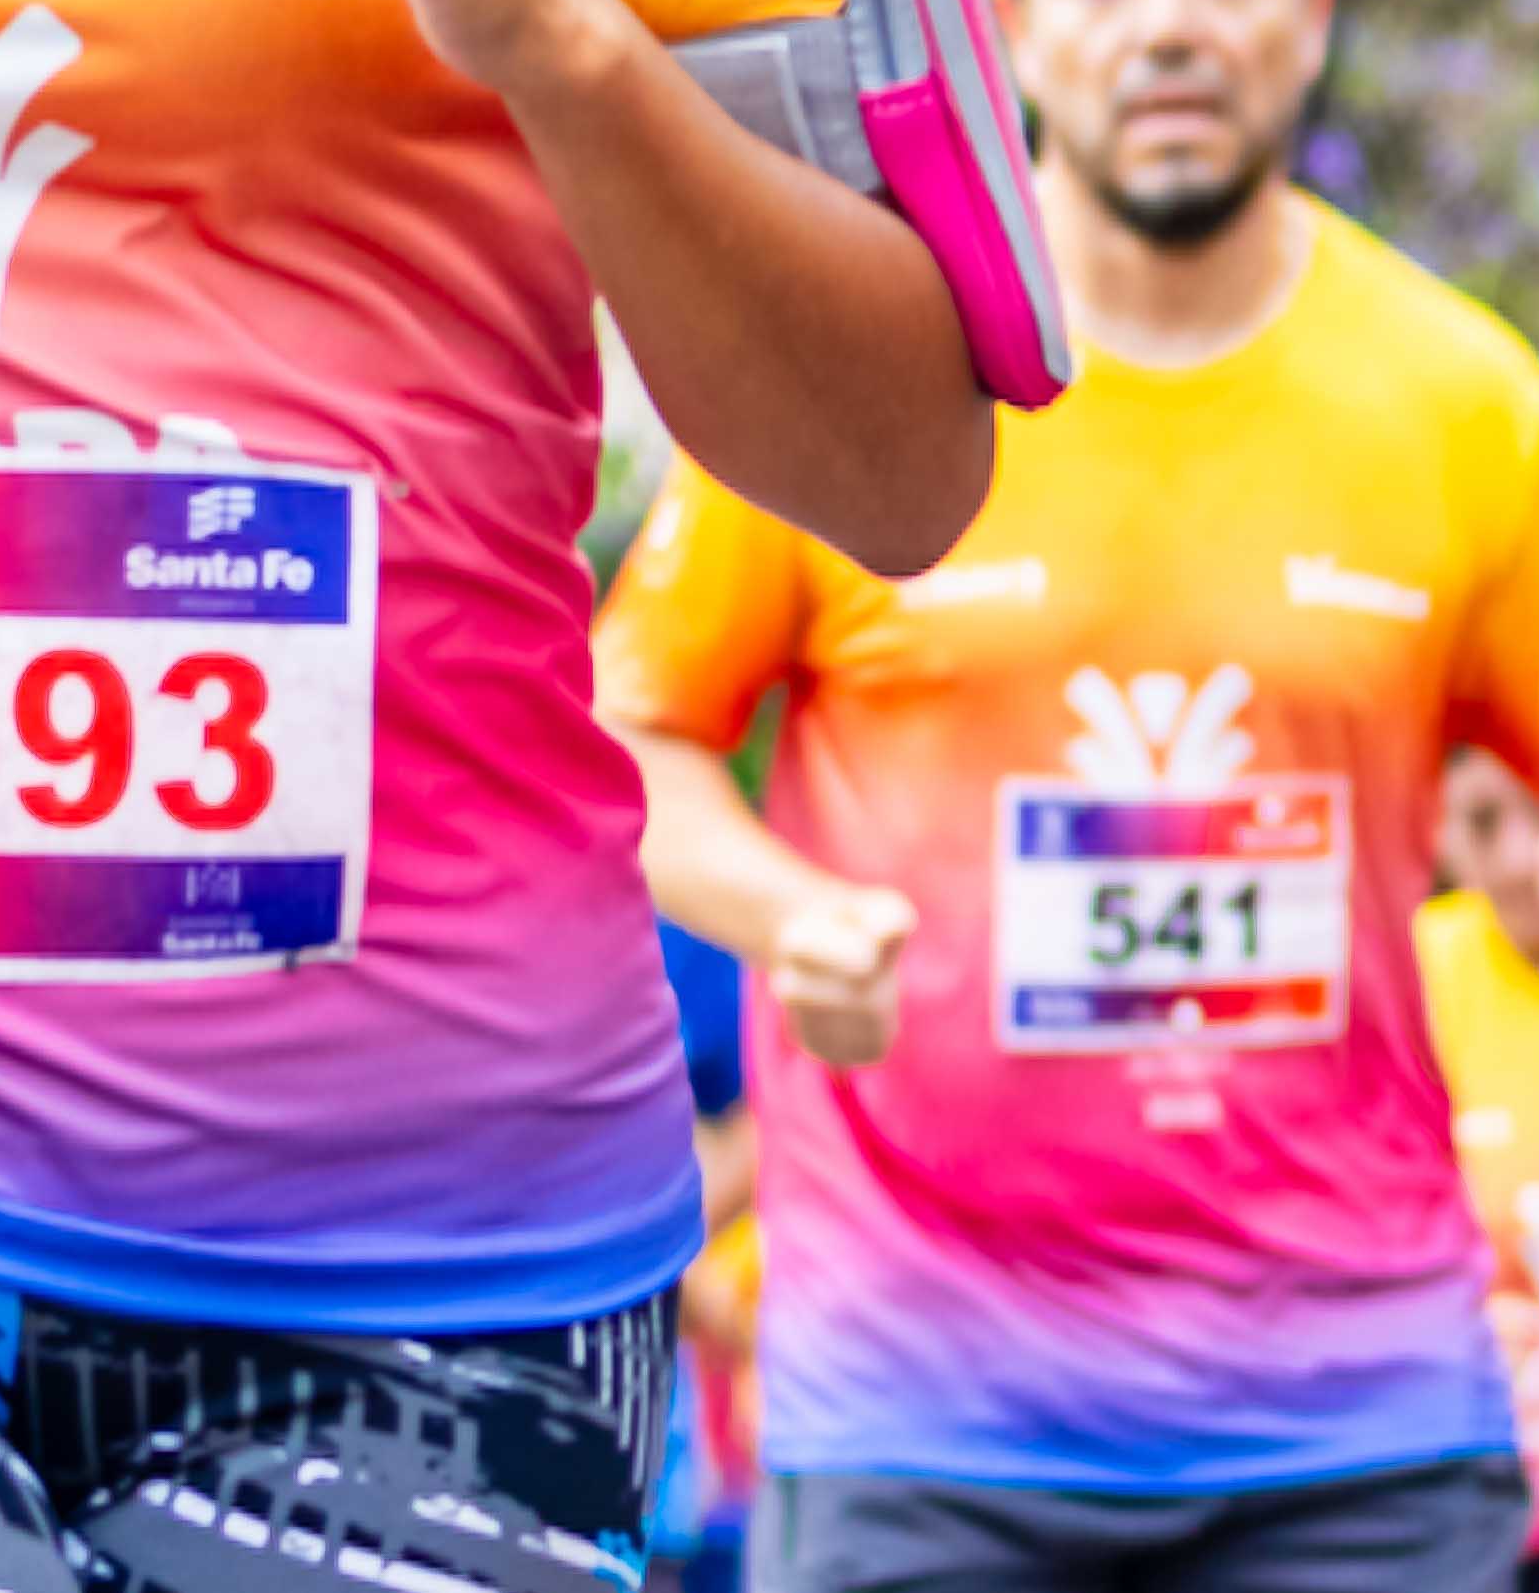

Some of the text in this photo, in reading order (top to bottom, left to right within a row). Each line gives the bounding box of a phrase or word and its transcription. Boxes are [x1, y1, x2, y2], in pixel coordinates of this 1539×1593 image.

[125, 543, 316, 593] Santa Fe
[1088, 880, 1265, 966] 541
